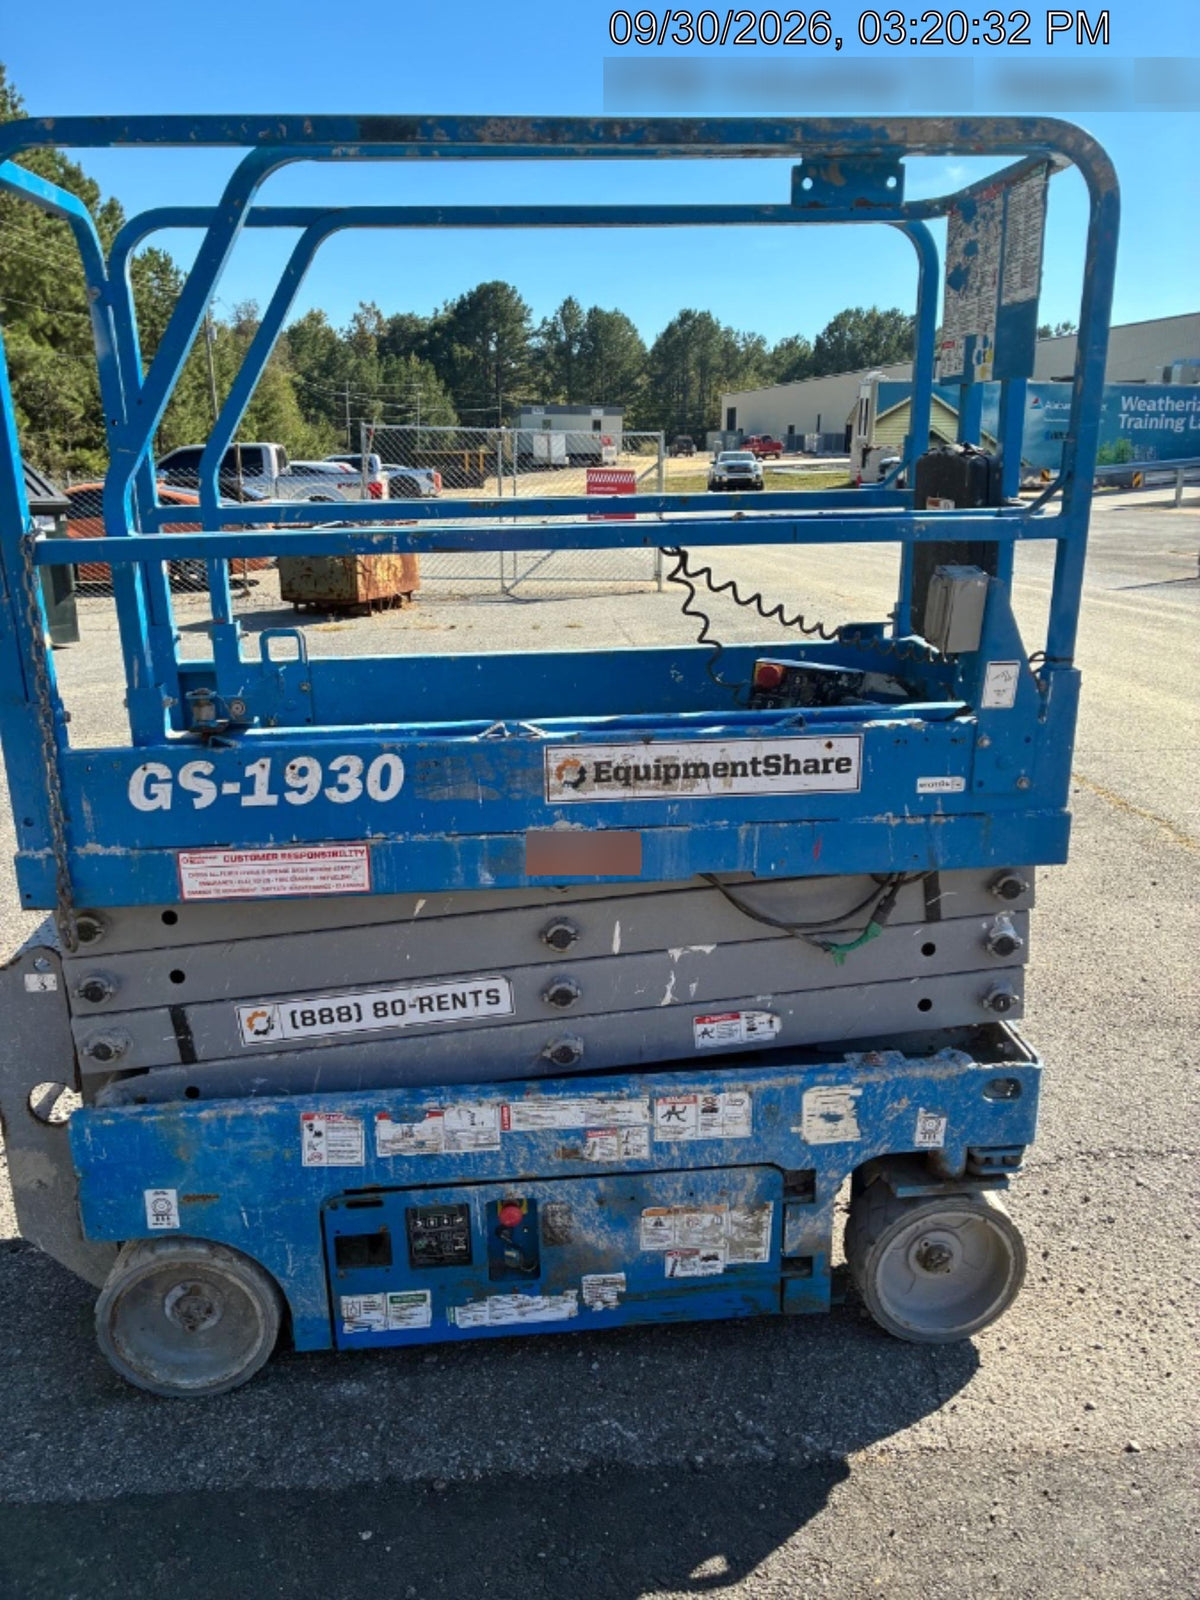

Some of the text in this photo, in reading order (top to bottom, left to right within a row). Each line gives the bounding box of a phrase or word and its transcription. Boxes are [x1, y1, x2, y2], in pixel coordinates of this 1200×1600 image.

[1118, 413, 1200, 433] Training L
[128, 753, 405, 812] GS-1930
[593, 753, 851, 786] EquipmentShare
[223, 852, 278, 863] CUSTOMER
[280, 849, 366, 862] RESPONSIBILITY
[290, 988, 501, 1030] (888) 80-RENTS
